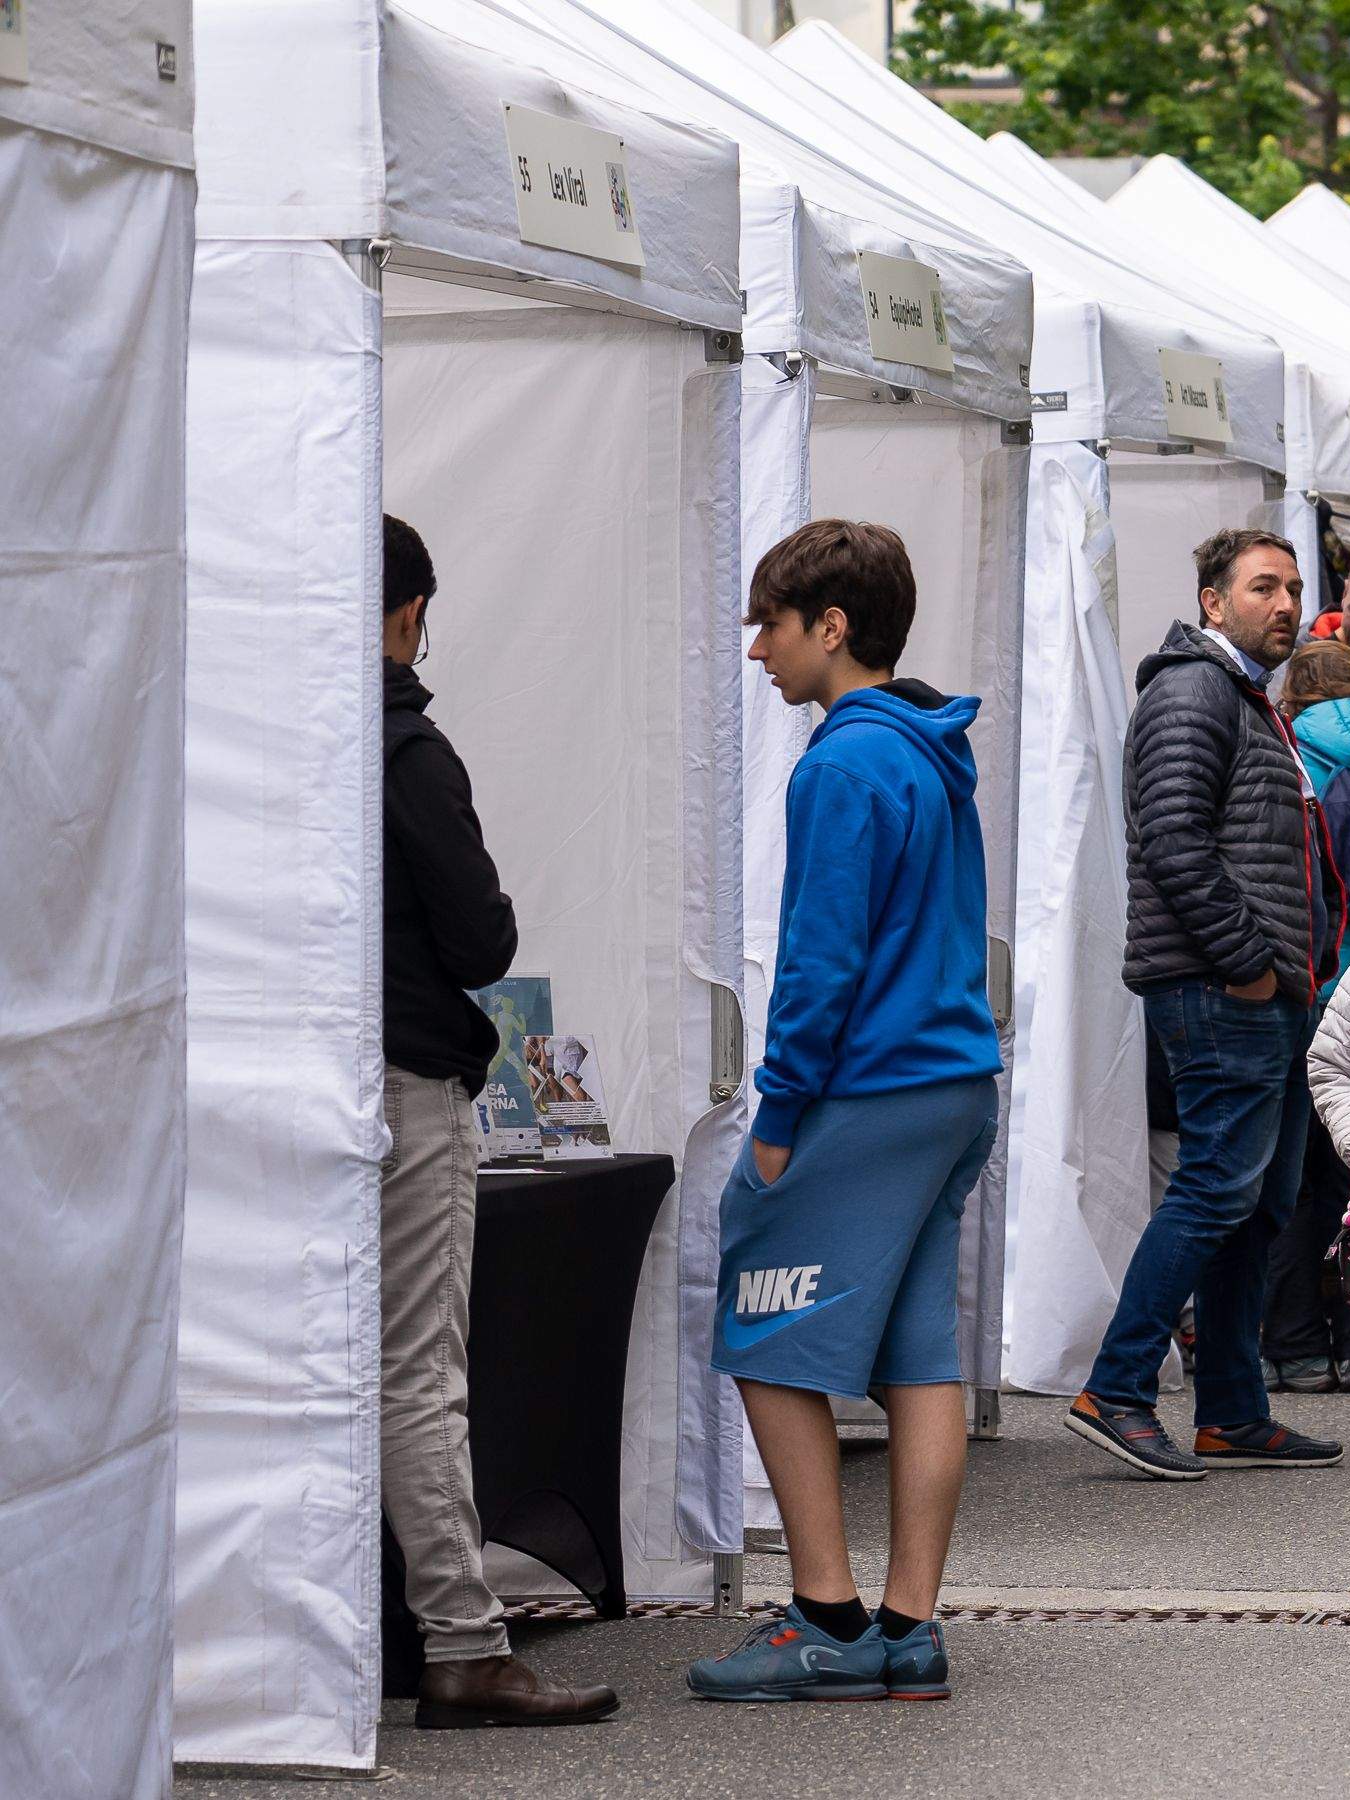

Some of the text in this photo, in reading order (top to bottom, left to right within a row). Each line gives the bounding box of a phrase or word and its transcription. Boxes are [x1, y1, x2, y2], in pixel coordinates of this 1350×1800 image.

[517, 155, 588, 208] 55 Lex Viral
[867, 290, 880, 320] 54
[735, 1264, 823, 1314] NIKE
